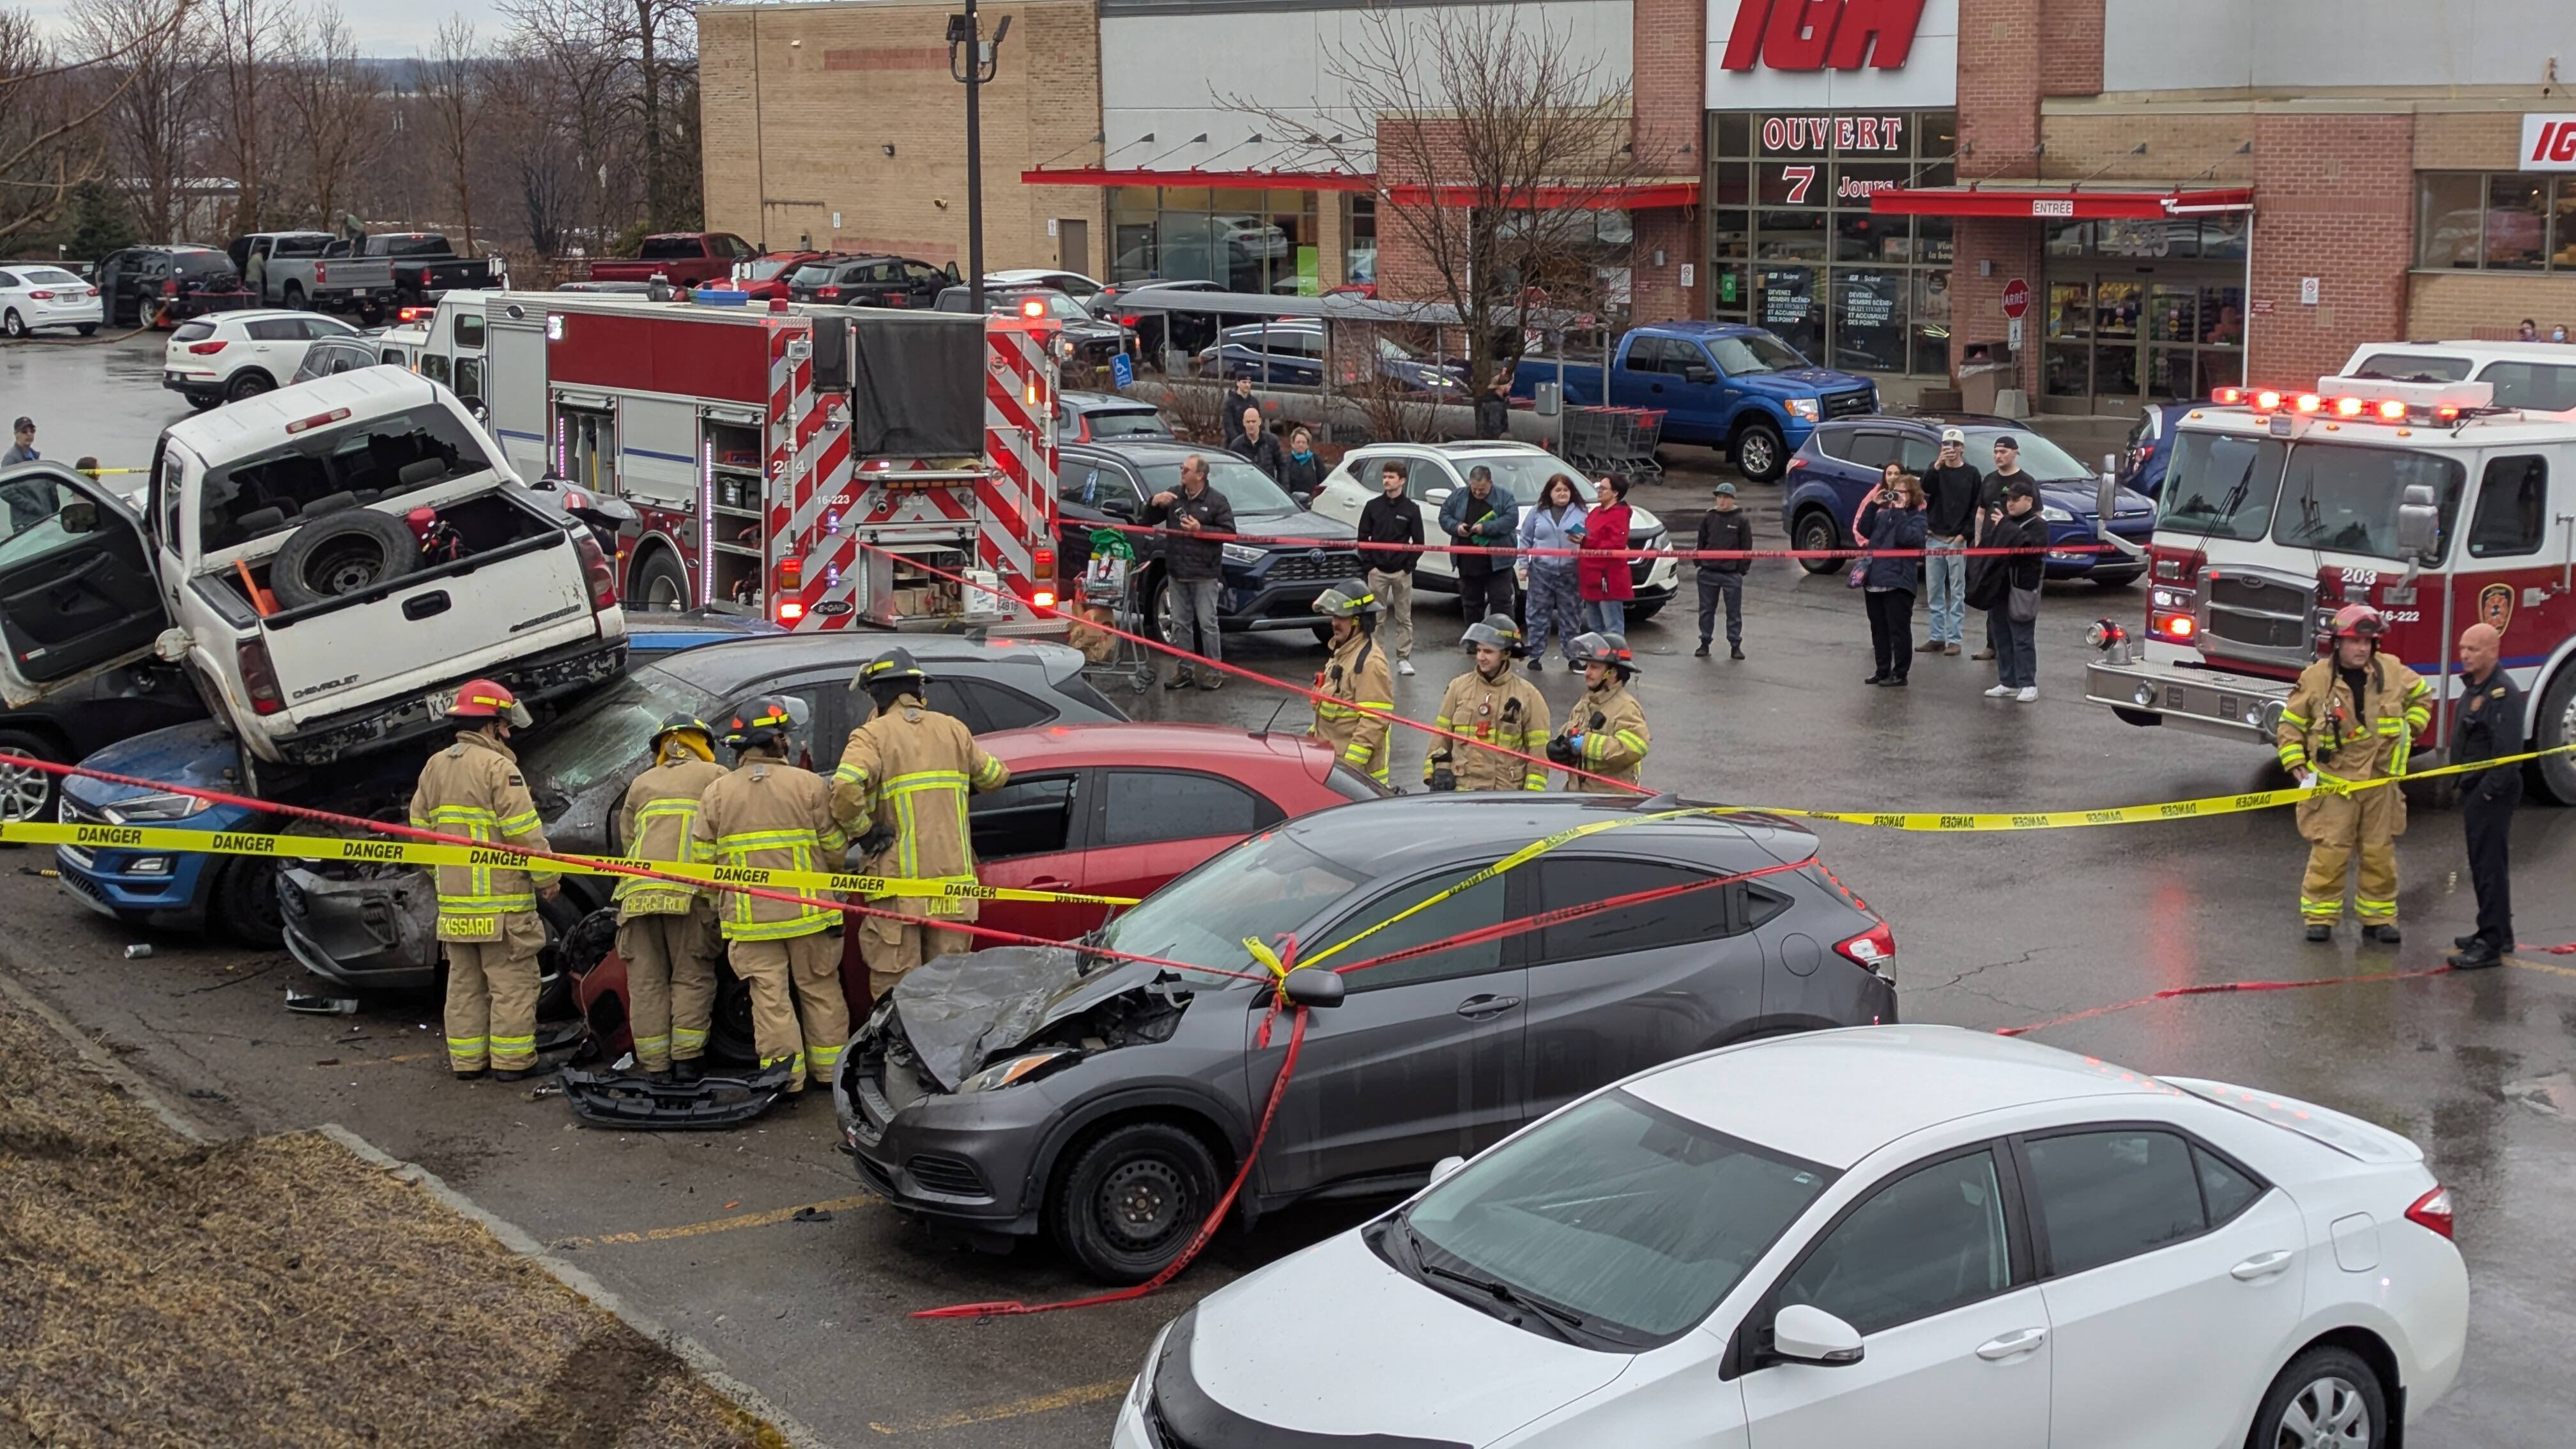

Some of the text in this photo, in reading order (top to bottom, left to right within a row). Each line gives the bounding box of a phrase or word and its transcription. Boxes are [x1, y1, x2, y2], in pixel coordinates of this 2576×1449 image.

[1721, 0, 1924, 71] IGA
[1763, 117, 1902, 150] OUVERT
[1782, 165, 1894, 203] 7 Jours
[2034, 200, 2072, 214] ENTRÉE
[2004, 289, 2028, 305] ARRÊT
[816, 494, 850, 505] 16-223
[1742, 550, 1786, 558] DANGER
[2340, 568, 2377, 585] 203
[292, 673, 360, 700] CHEVROLET
[77, 827, 142, 845] DANGER
[212, 834, 275, 852] DANGER
[343, 842, 404, 859] DANGER
[470, 850, 529, 867] DANGER
[713, 867, 770, 884] DANGER
[830, 876, 885, 891] DANGER
[944, 884, 997, 900] DANGER
[624, 895, 689, 913] BERGERON
